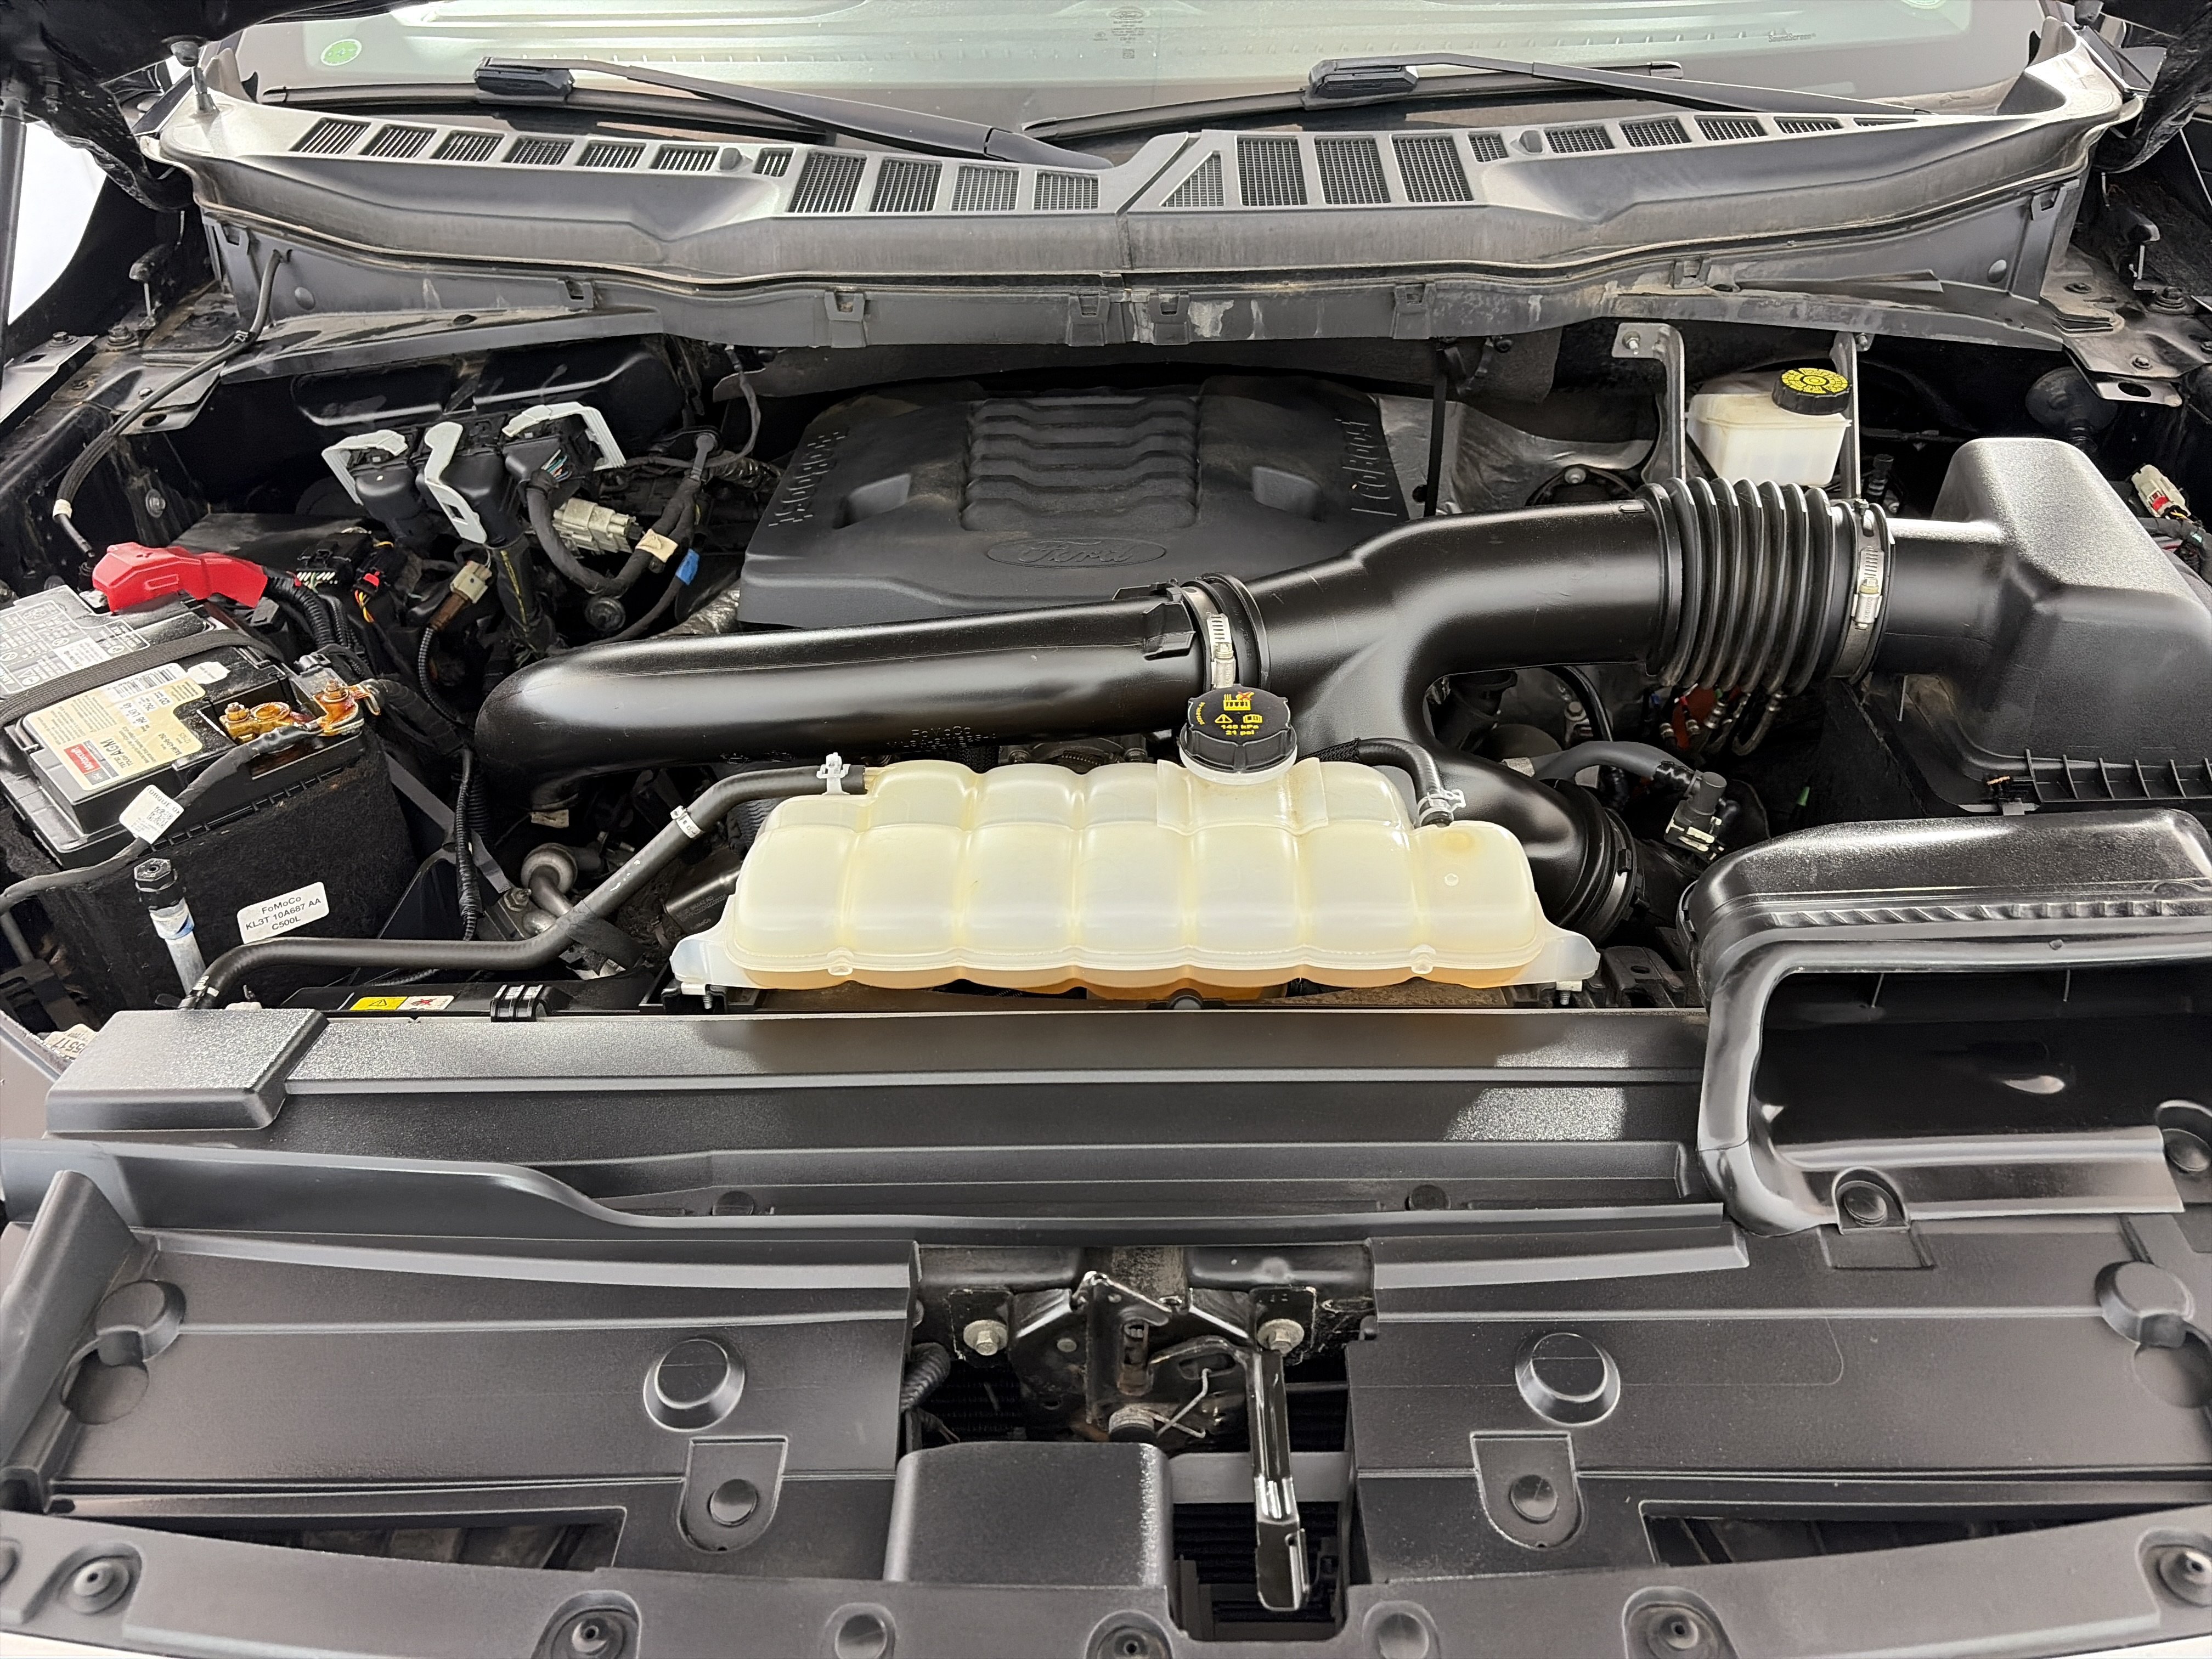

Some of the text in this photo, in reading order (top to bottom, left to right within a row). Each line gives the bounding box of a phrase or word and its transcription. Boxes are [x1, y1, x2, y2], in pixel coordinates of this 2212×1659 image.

[1018, 540, 1135, 562] Ford
[99, 738, 124, 757] AGM
[69, 746, 96, 770] Motorcraft
[245, 898, 321, 930] KL3T 10A687 AA
[262, 896, 301, 914] FoMoCo
[272, 916, 301, 930] C500L
